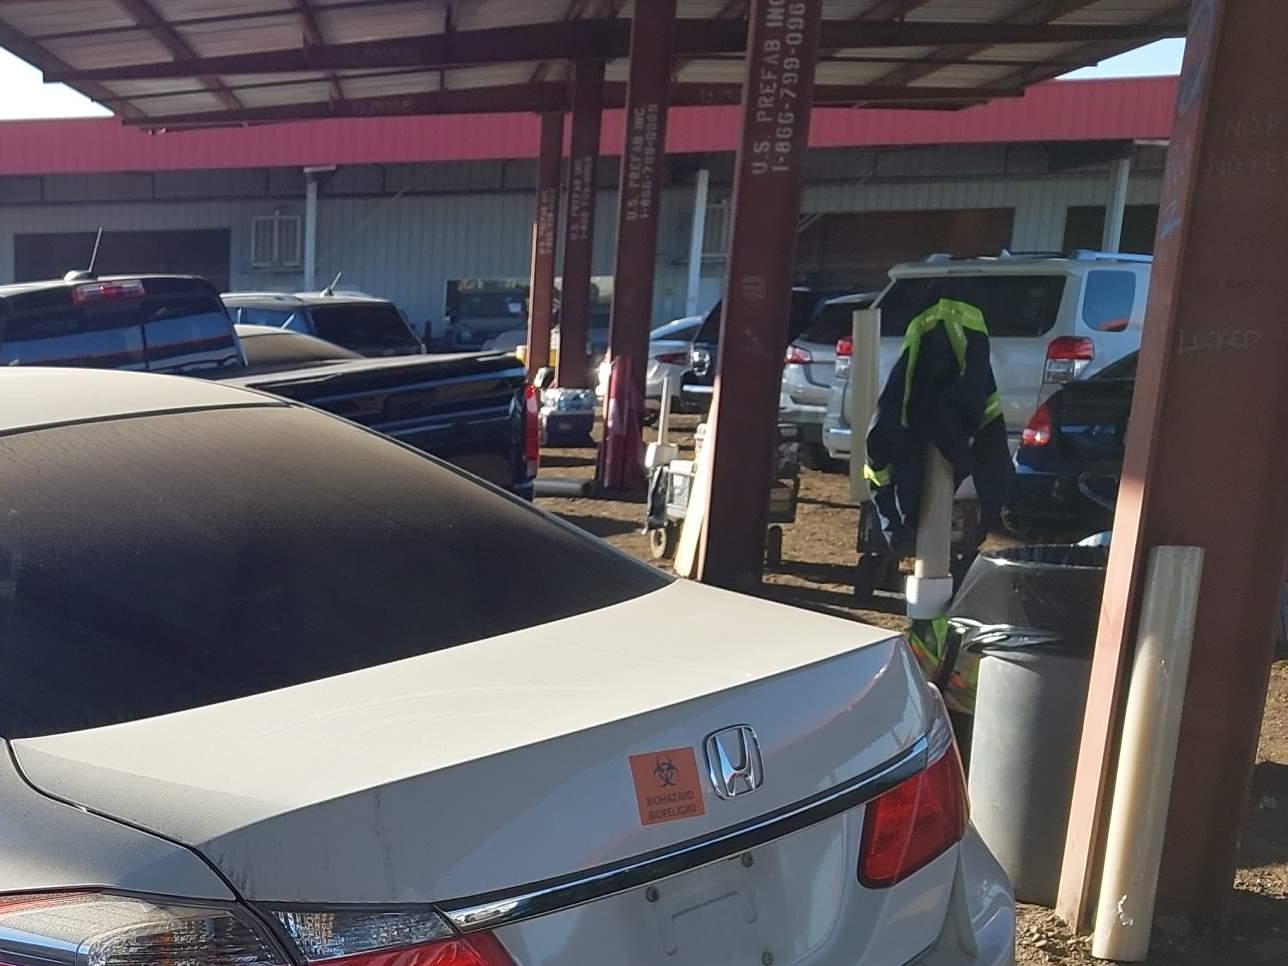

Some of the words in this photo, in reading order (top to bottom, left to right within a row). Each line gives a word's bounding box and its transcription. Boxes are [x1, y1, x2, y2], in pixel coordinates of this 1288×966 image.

[756, 39, 781, 122] PREFAB
[751, 135, 771, 175] U.S.
[646, 790, 695, 806] BIOHAZARD
[648, 804, 697, 820] BIOPELIGRO
